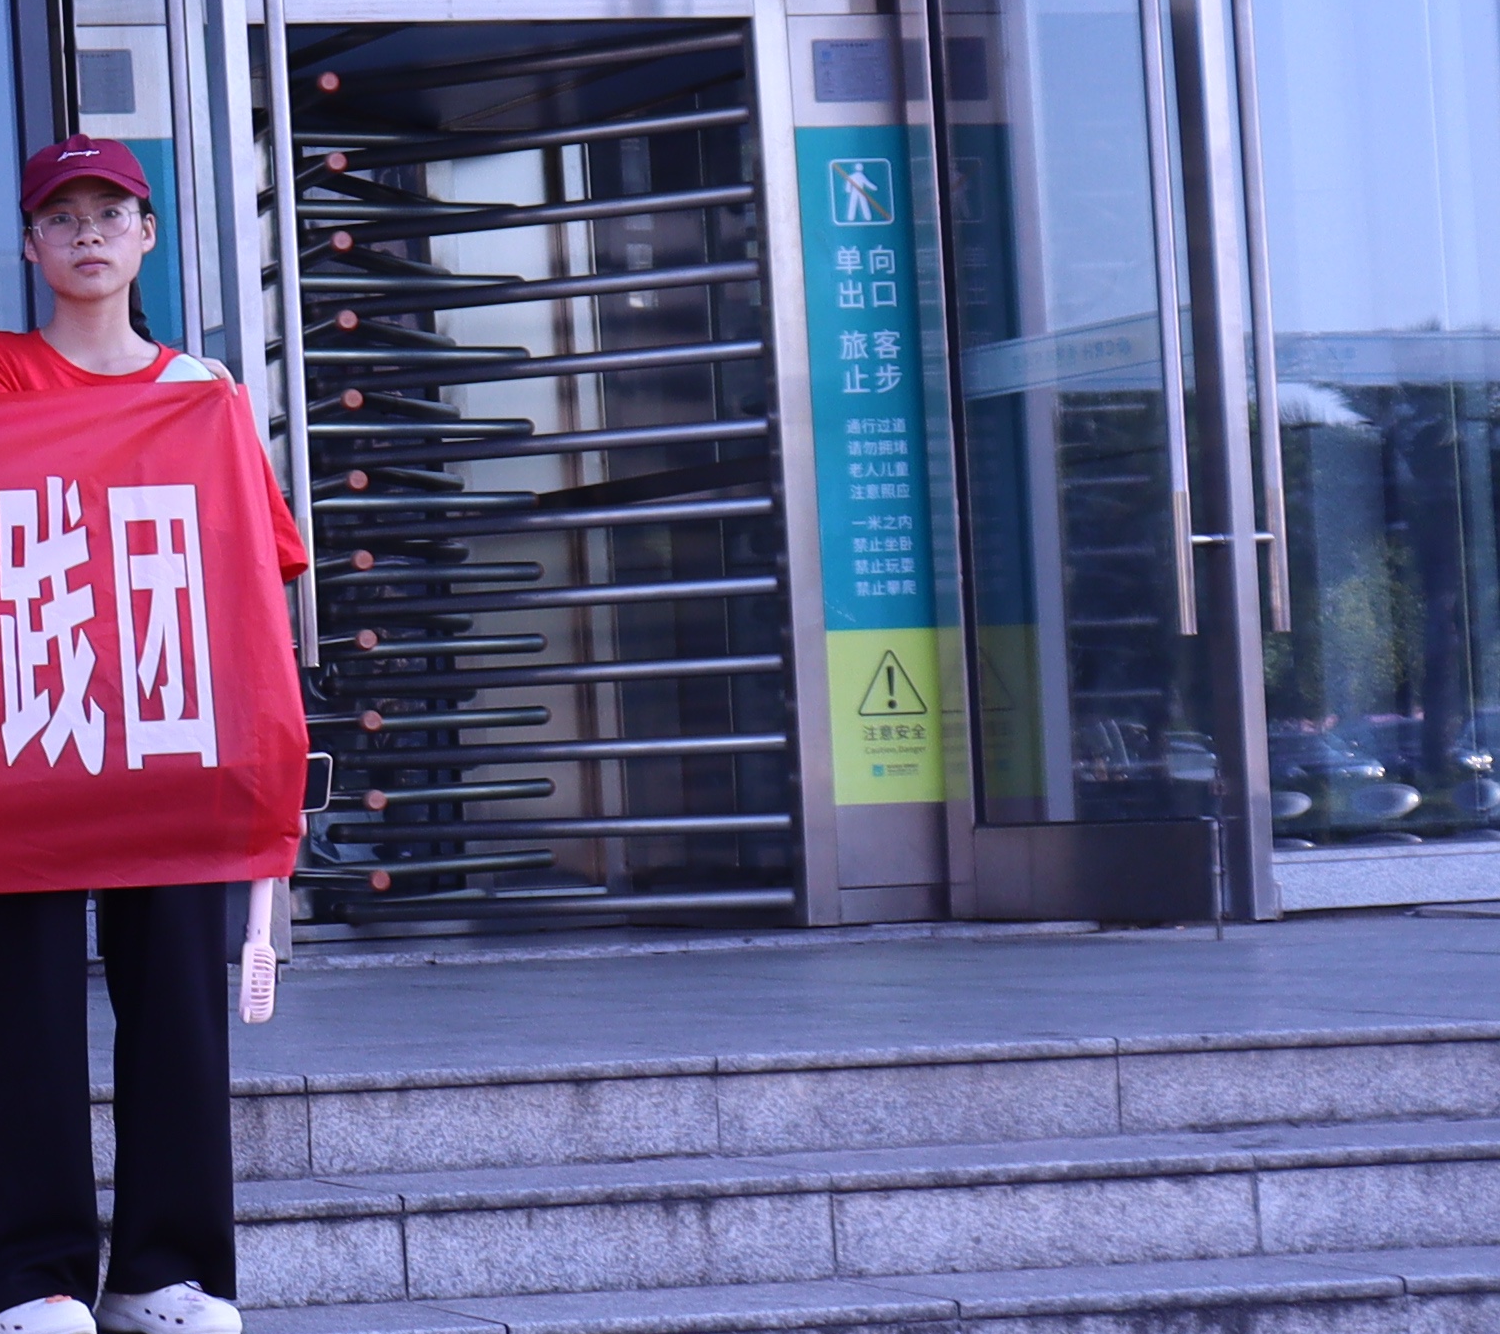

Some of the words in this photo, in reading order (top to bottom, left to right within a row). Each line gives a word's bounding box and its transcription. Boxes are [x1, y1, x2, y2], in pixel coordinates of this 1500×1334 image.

[835, 244, 897, 276] 单向
[838, 279, 898, 310] 出口
[840, 328, 902, 362] 旅客
[843, 363, 903, 394] 止步
[851, 514, 913, 531] 一米之内
[862, 723, 927, 741] 注意安全
